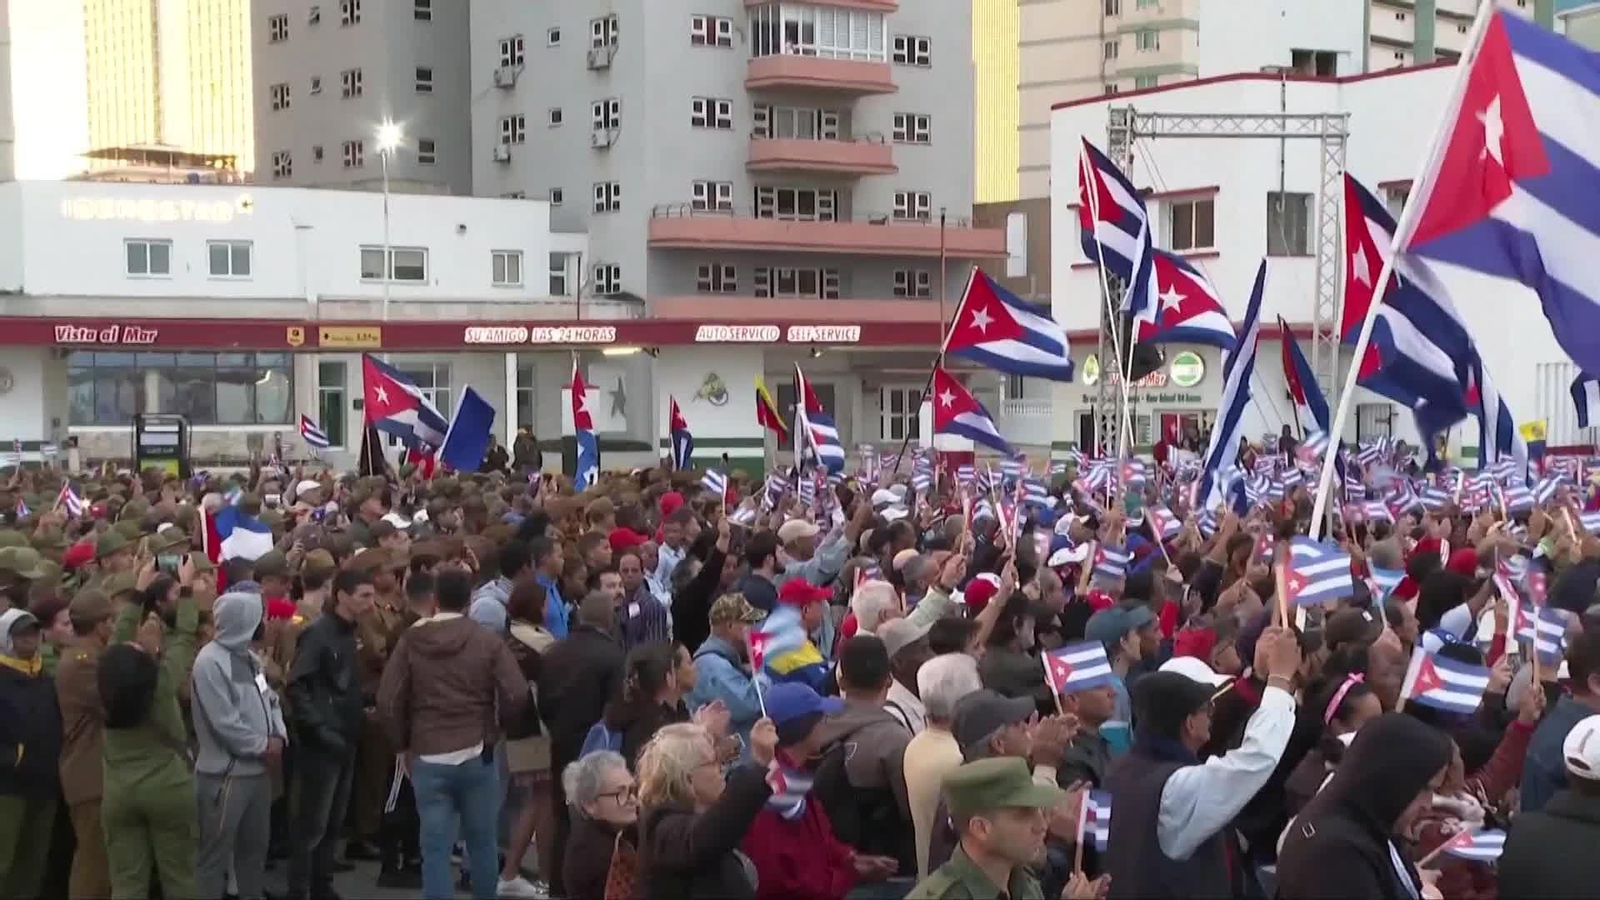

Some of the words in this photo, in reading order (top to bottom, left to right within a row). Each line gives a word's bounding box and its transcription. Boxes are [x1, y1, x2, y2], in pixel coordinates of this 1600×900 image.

[55, 325, 97, 342] Vista
[100, 325, 119, 343] al
[122, 326, 157, 343] Mar
[466, 327, 481, 341] SU
[486, 327, 527, 341] AMIGO
[533, 327, 553, 342] LAS
[559, 327, 572, 341] 24
[575, 327, 614, 341] HORAS
[788, 326, 811, 341] SELF
[814, 326, 859, 341] SERVICE
